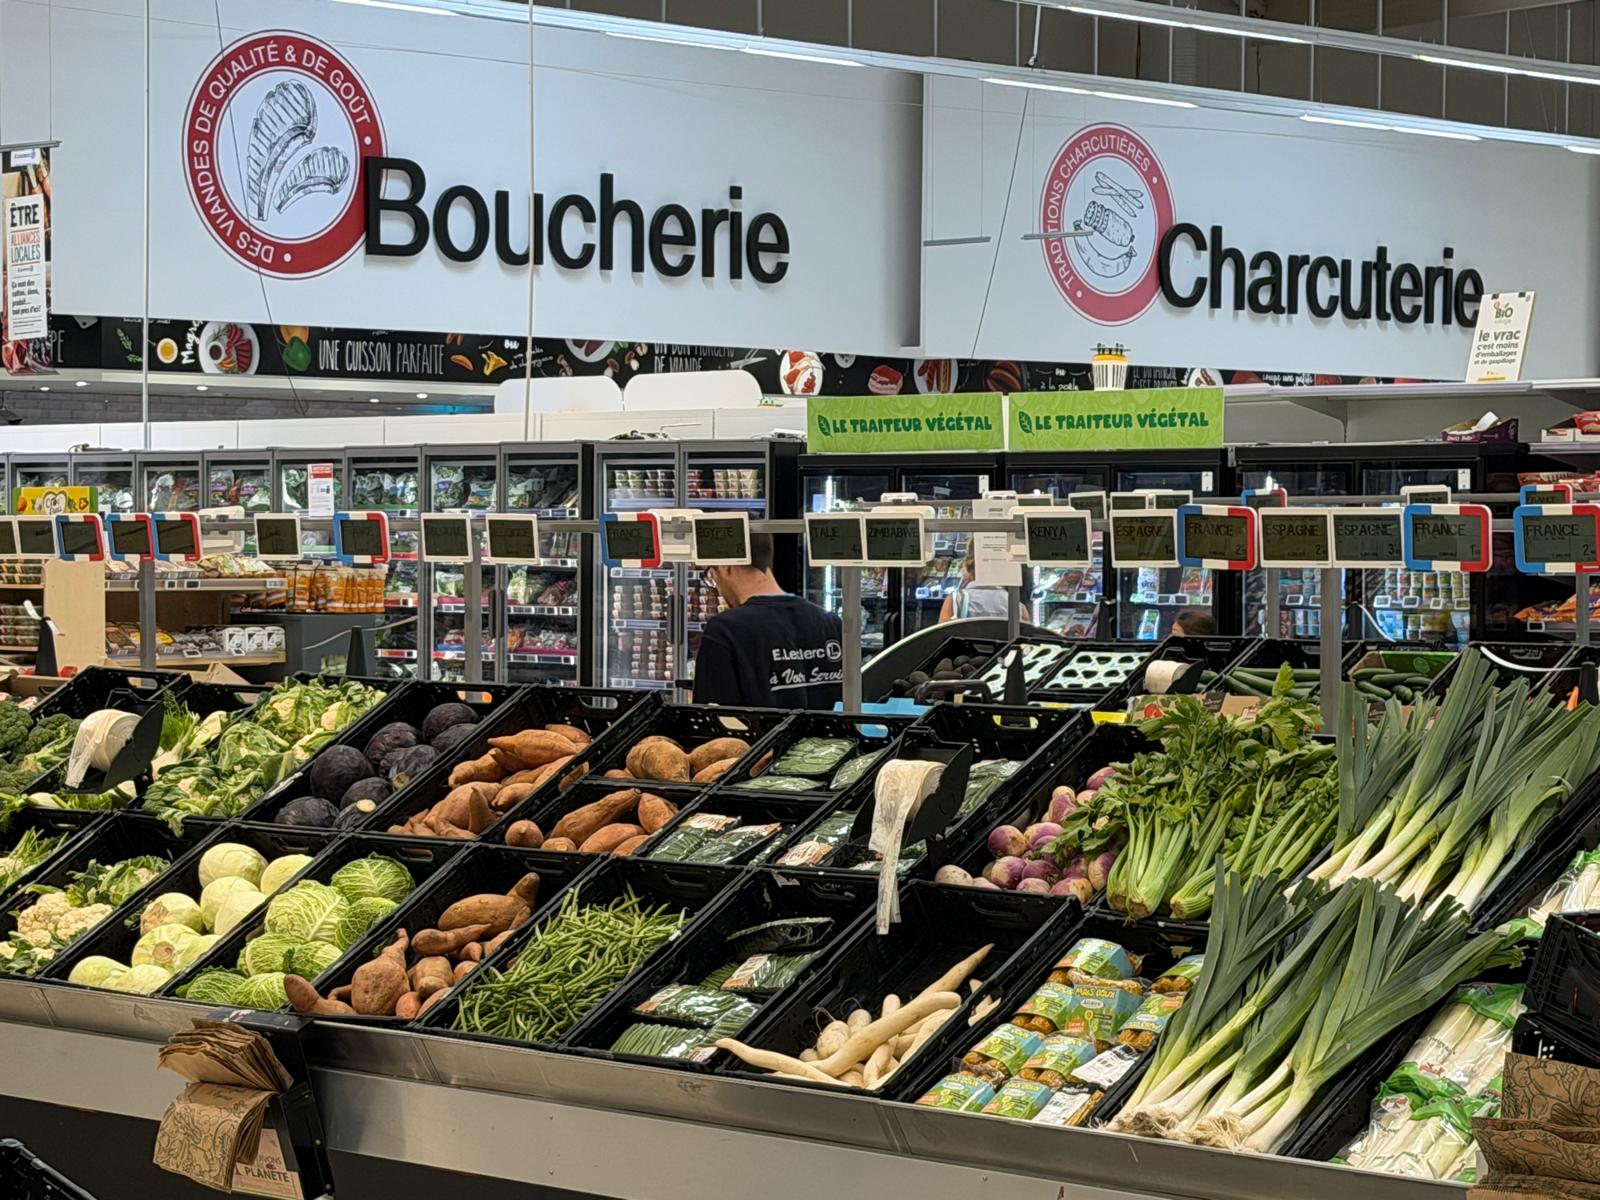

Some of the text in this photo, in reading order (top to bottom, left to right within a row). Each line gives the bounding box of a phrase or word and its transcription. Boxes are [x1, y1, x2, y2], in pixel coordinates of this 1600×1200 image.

[193, 40, 371, 264] DES VIANDES DE QUALITÉ & DE GOÛT
[10, 202, 40, 228] ÊTRE
[365, 156, 790, 285] Boucherie
[1046, 134, 1151, 291] TRADTIONS CHARCUTIÈRES
[11, 230, 41, 247] ALLIANCES
[11, 244, 41, 264] LOCALES
[1159, 222, 1485, 330] Charcuterie
[1478, 330, 1521, 342] le vrac
[319, 339, 445, 375] UNE CUISSON PARFAITE
[832, 410, 993, 433] LE TRAITEUR VÉGÉTAL
[1035, 407, 1209, 431] LE TRAITEUR VÉGÉTAL
[1029, 526, 1068, 537] KENYA
[1116, 525, 1168, 537] ESPAGNE
[1187, 522, 1233, 537] FRANCE
[1265, 524, 1319, 537] ESPAGNE
[1336, 524, 1393, 537] ESPAGNE
[1415, 523, 1466, 536] FRANCE
[1525, 524, 1580, 537] FRANCE
[772, 648, 825, 662] E.Leclerc
[810, 666, 843, 682] Servi
